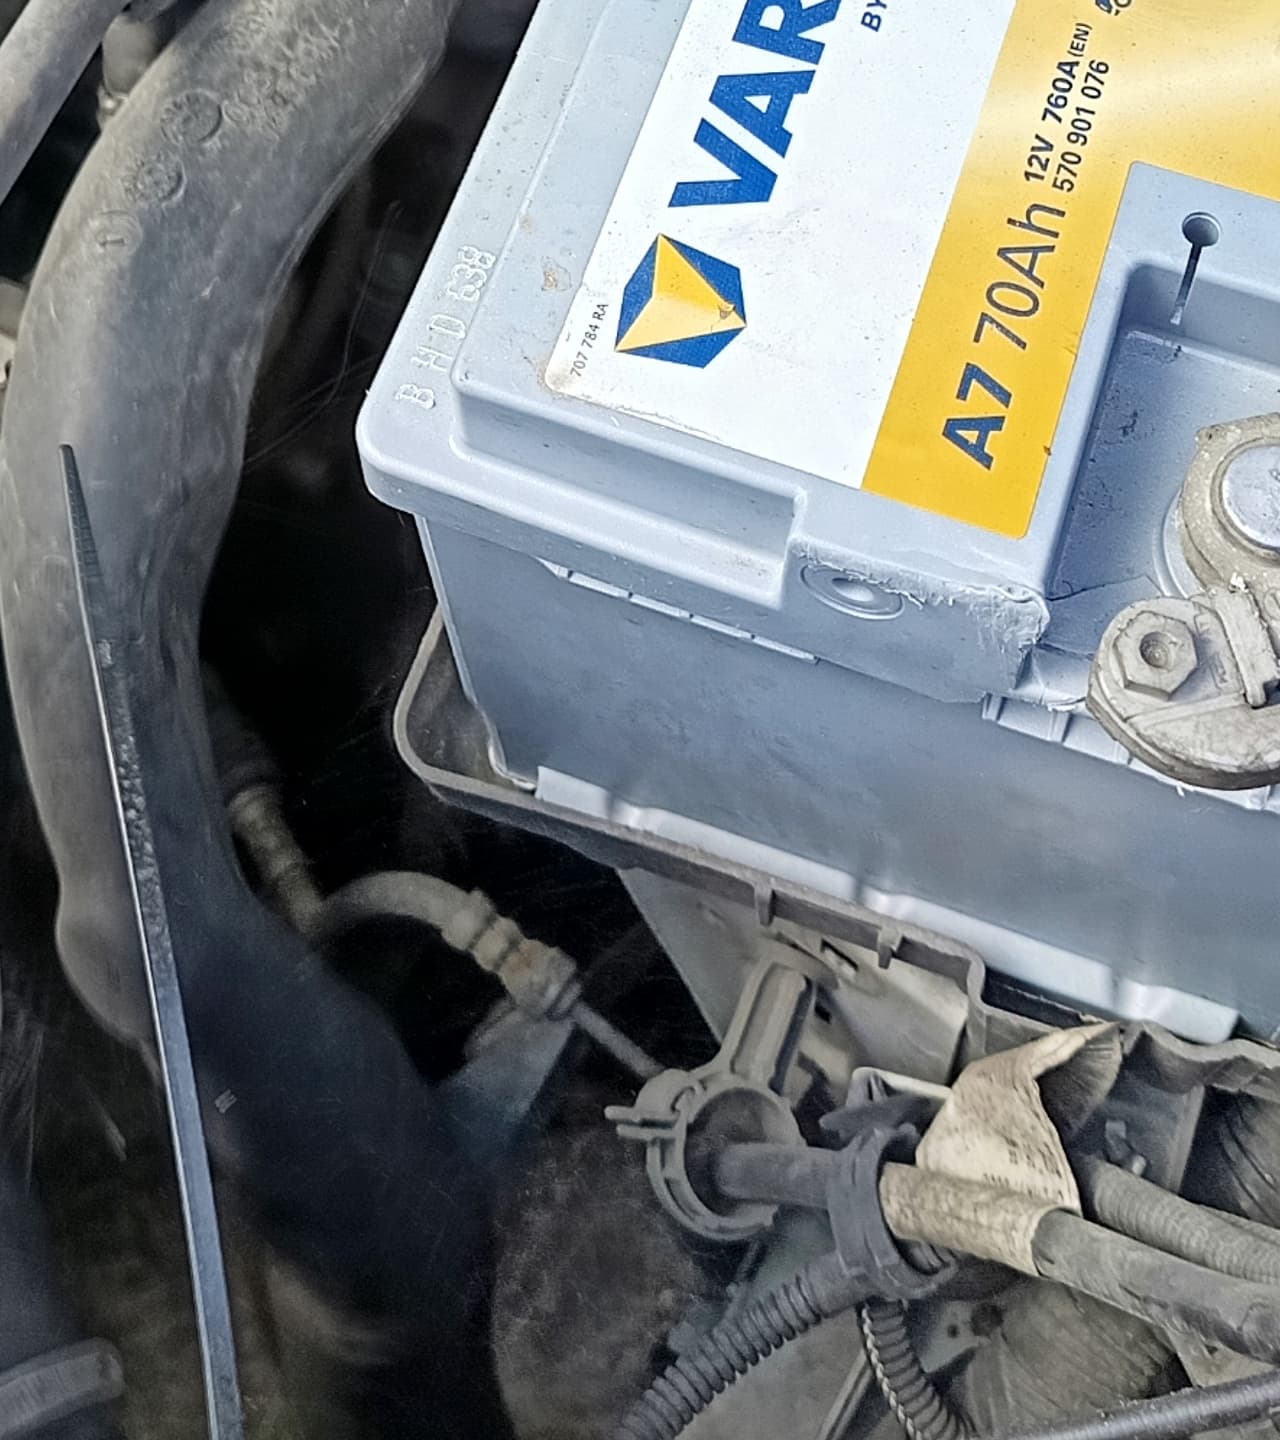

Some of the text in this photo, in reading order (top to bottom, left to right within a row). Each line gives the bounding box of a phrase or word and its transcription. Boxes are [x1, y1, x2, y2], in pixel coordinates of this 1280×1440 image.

[1024, 133, 1055, 183] 12V
[1052, 59, 1111, 193] 570 901 076
[569, 300, 609, 379] 707 784 RA
[941, 202, 1066, 471] A7 70Ah
